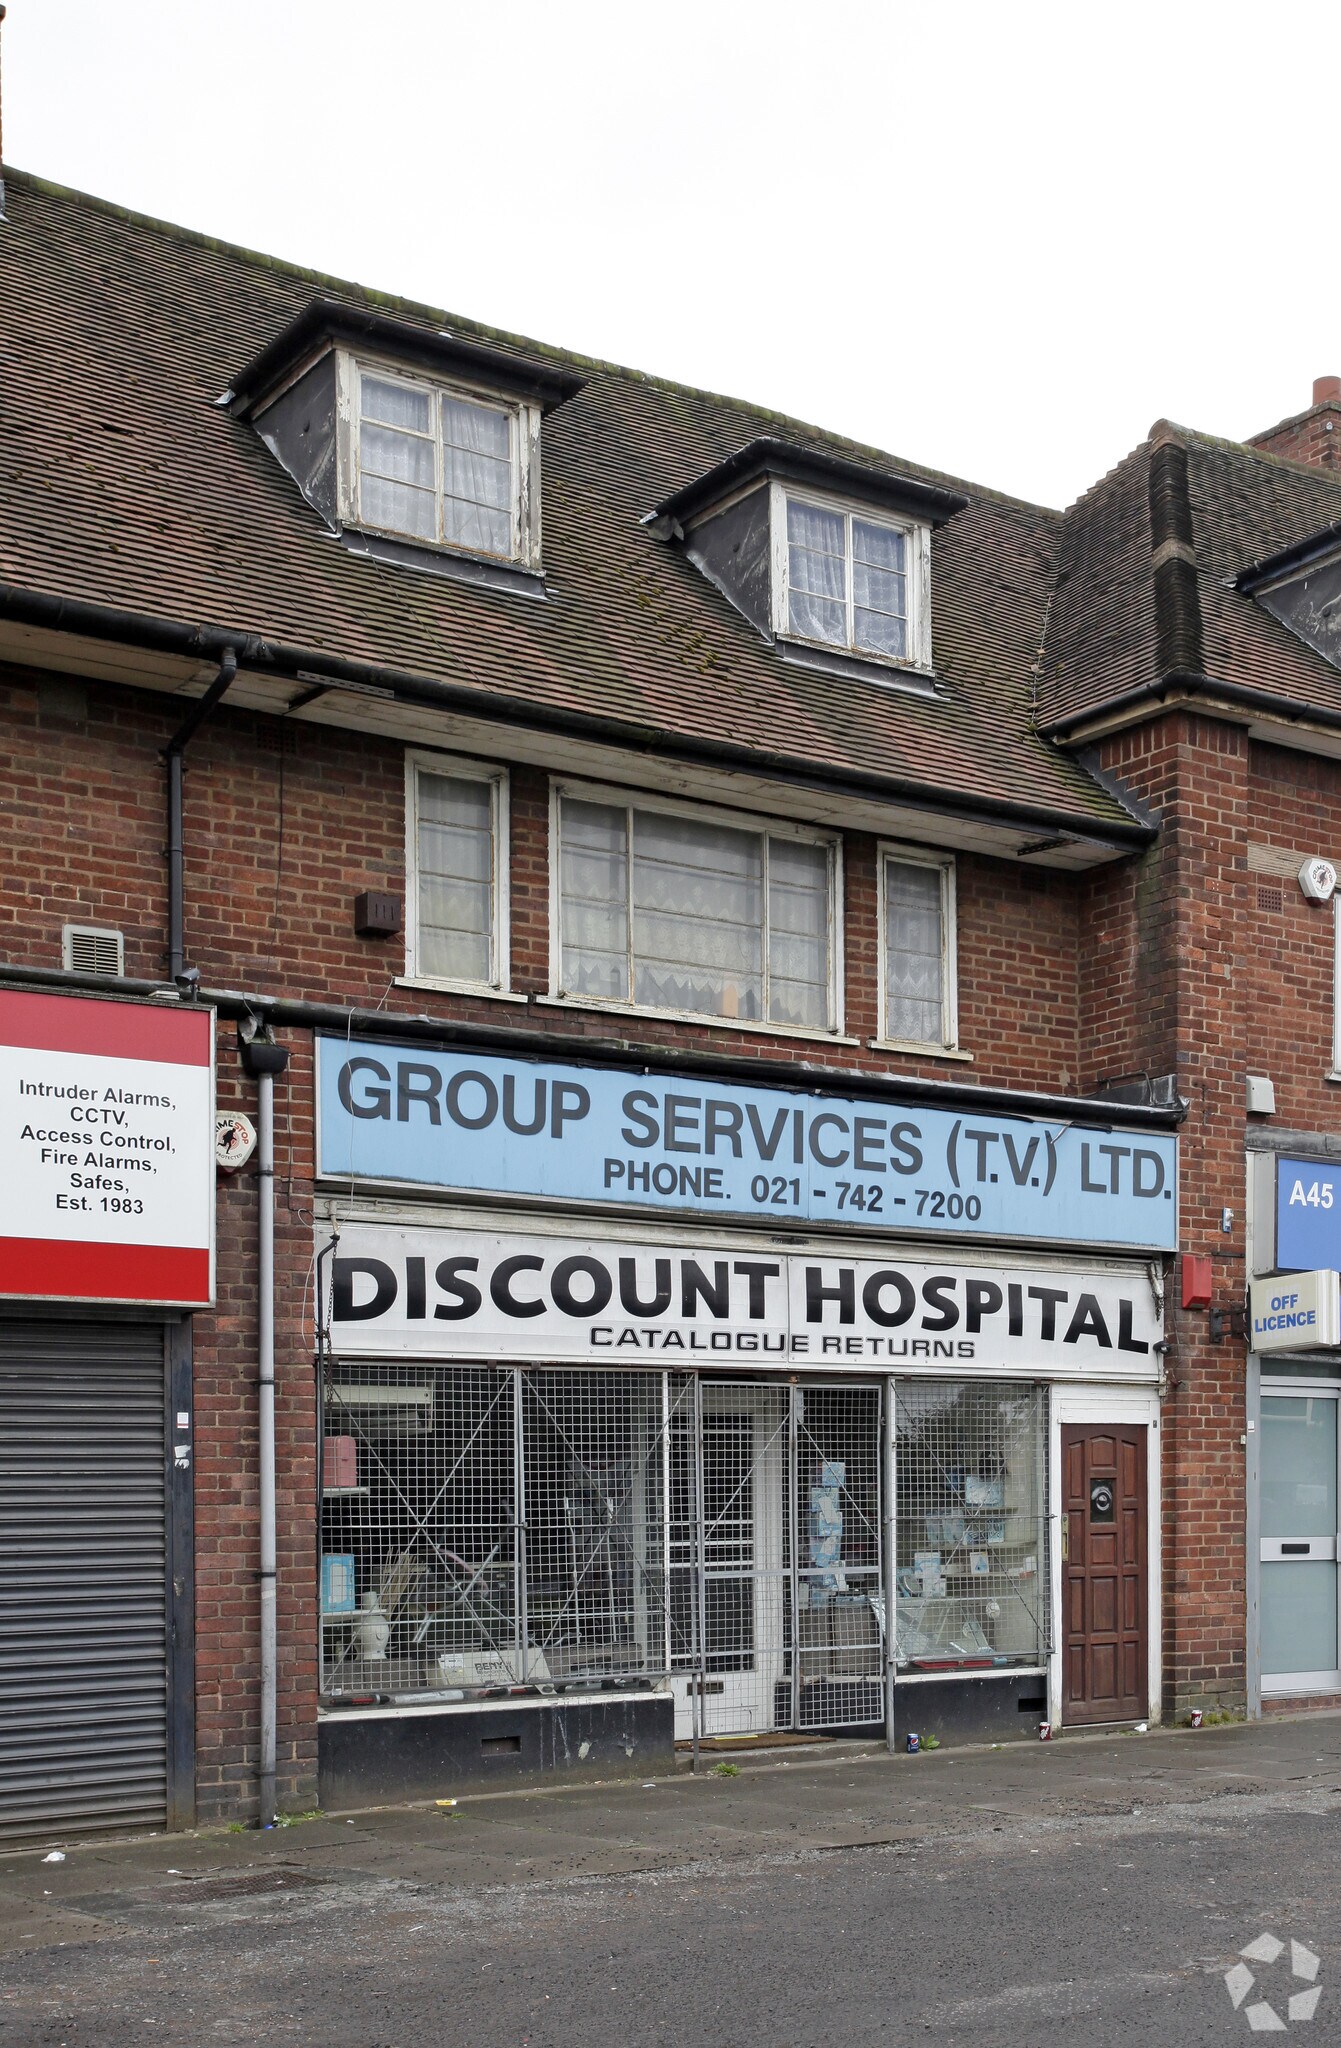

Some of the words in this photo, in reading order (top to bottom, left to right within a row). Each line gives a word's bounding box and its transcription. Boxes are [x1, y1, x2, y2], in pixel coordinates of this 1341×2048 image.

[19, 1079, 98, 1100] Intruder
[104, 1088, 177, 1110] Alarms,
[70, 1106, 129, 1129] CCTV,
[337, 1056, 591, 1139] GROUP
[621, 1090, 923, 1175] SERVICES
[946, 1119, 1058, 1196] (T.V.)
[1081, 1142, 1173, 1200] LTD.
[20, 1125, 93, 1145] Access
[100, 1132, 176, 1154] Control,
[41, 1149, 78, 1166] Fire
[84, 1152, 158, 1174] Alarms,
[70, 1173, 130, 1193] Safes,
[604, 1158, 731, 1199] PHONE.
[56, 1194, 92, 1211] Est.
[100, 1197, 144, 1214] 1983
[1288, 1180, 1334, 1209] A45
[332, 1254, 780, 1322] DISCOUNT
[805, 1266, 1149, 1355] HOSPITAL
[1270, 1294, 1299, 1312] OFF
[1254, 1310, 1316, 1333] LICENCE
[590, 1327, 809, 1354] CATALOGUE
[822, 1335, 976, 1359] RETURNS
